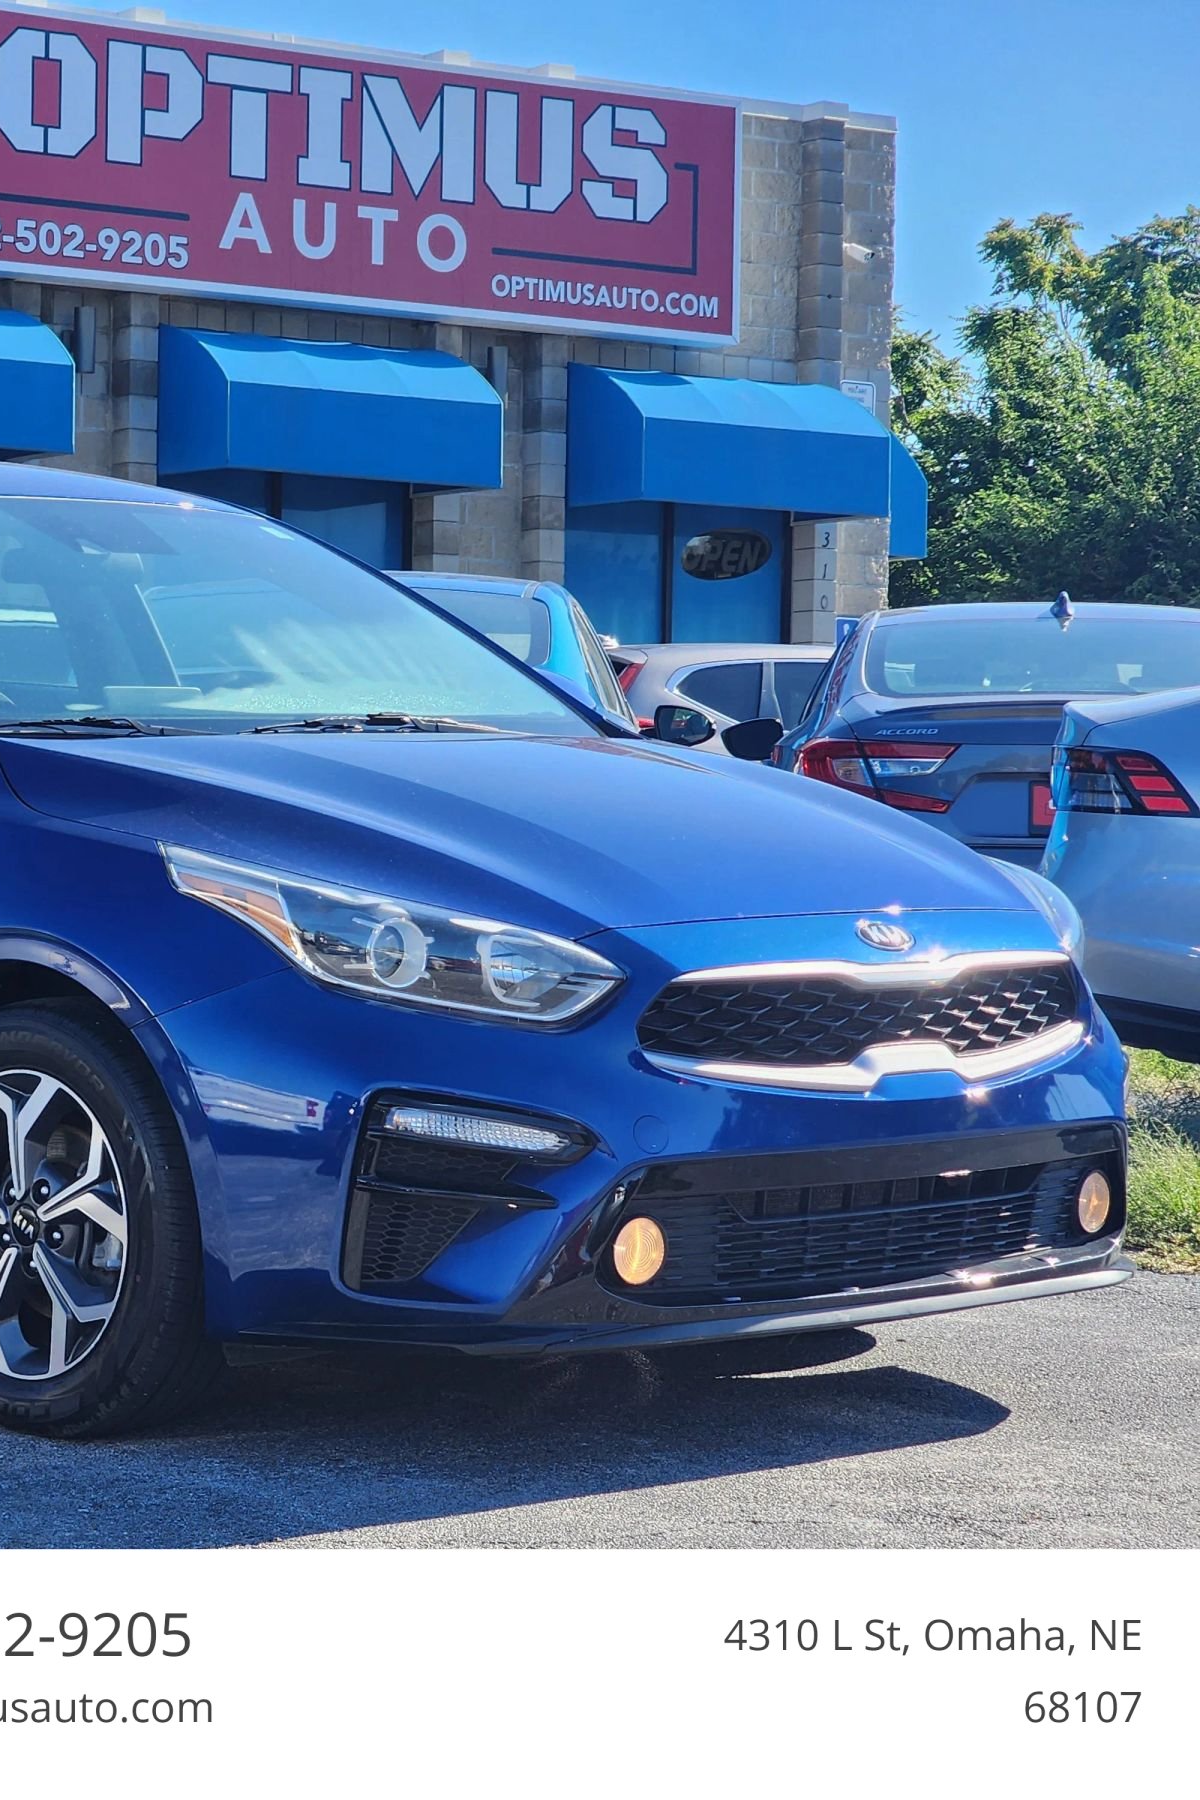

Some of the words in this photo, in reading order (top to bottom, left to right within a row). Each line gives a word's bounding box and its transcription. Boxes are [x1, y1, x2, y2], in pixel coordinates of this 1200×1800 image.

[219, 192, 468, 273] AUTO
[491, 274, 719, 318] OPTIMUSAUTO.COM
[684, 539, 764, 573] OPEN
[874, 728, 939, 736] ACCORD
[13, 1209, 34, 1239] KIA
